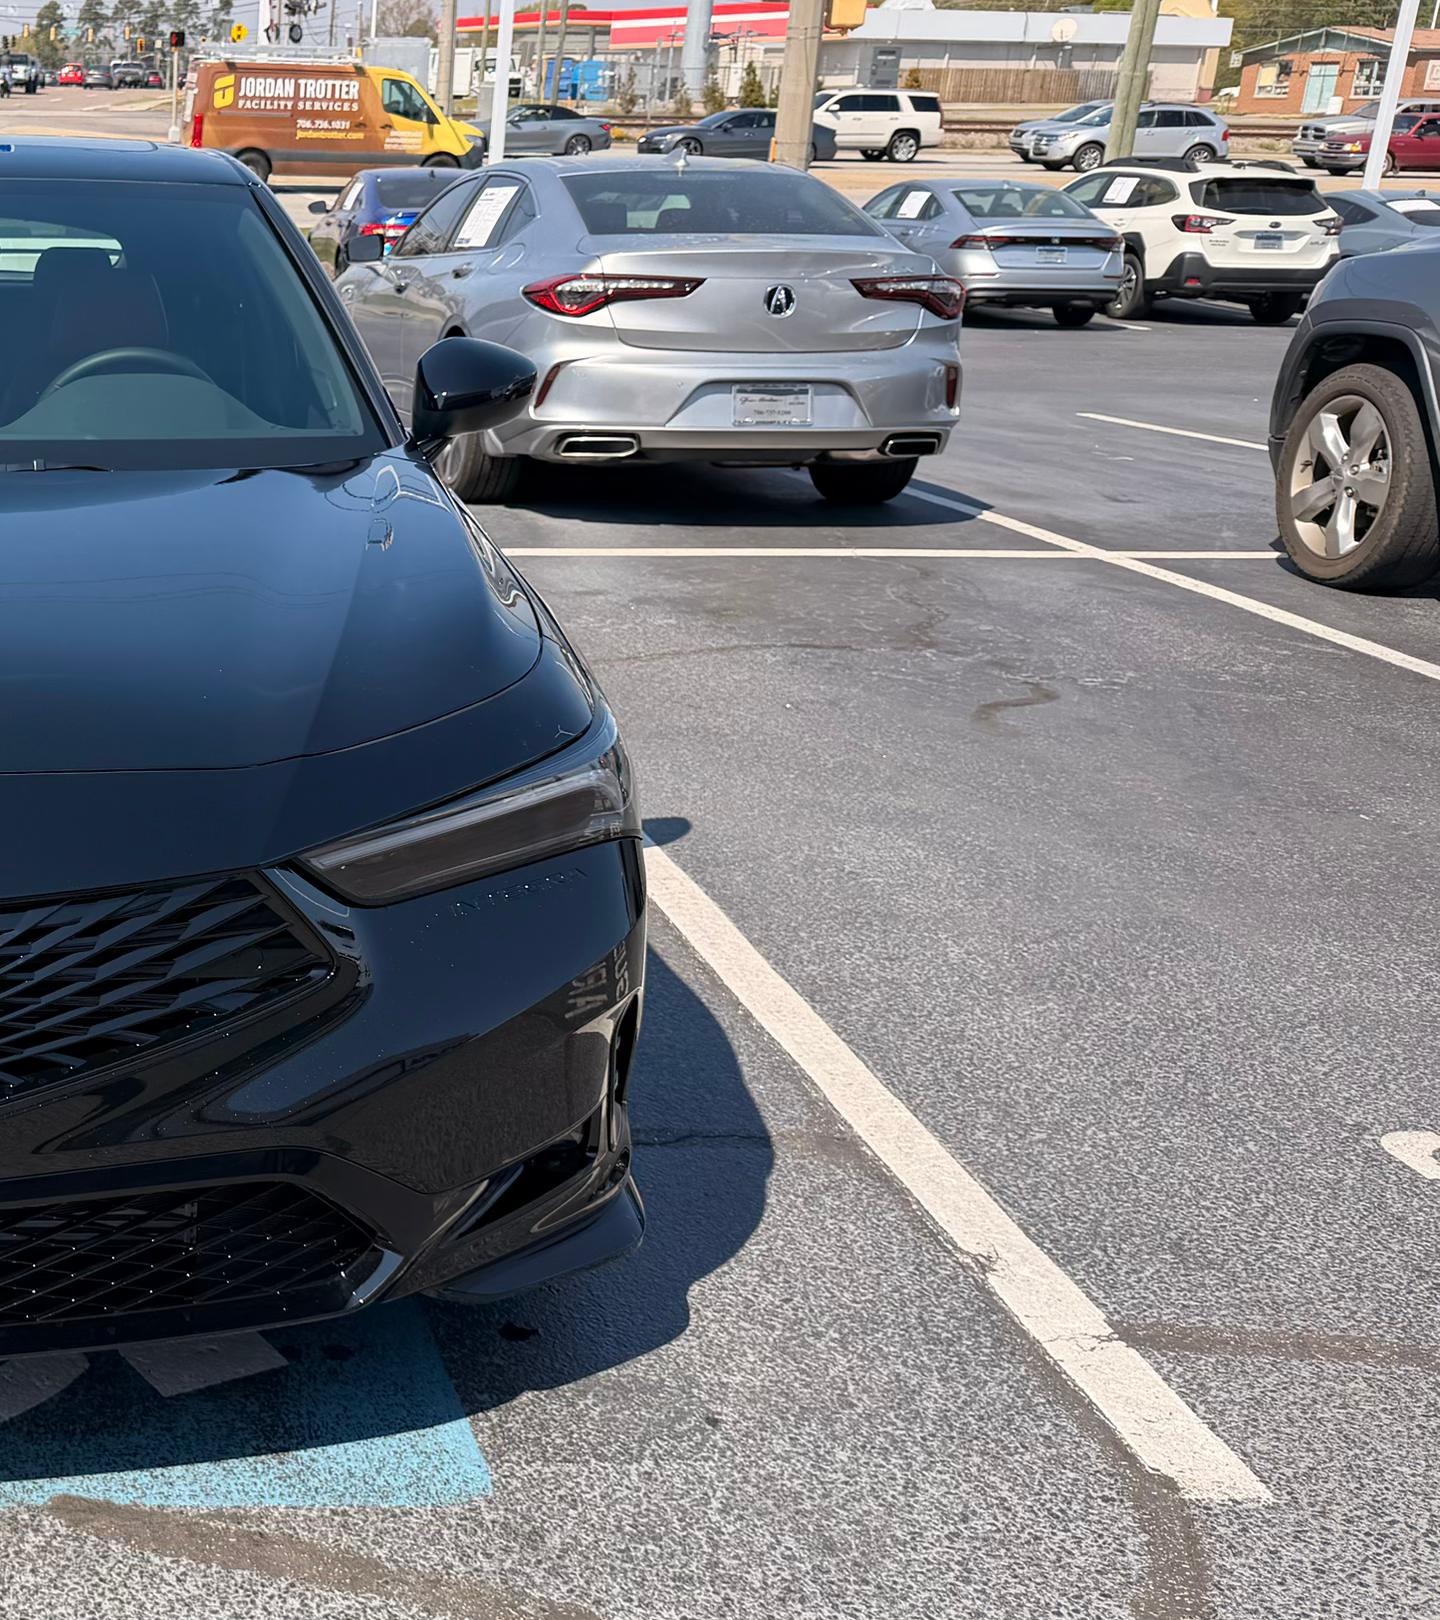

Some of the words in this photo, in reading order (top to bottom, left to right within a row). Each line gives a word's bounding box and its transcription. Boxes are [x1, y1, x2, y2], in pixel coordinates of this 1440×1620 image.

[238, 77, 295, 98] JORDAN
[297, 79, 360, 100] TROTTER
[238, 99, 294, 110] FACILITY
[297, 100, 359, 112] SERVICES
